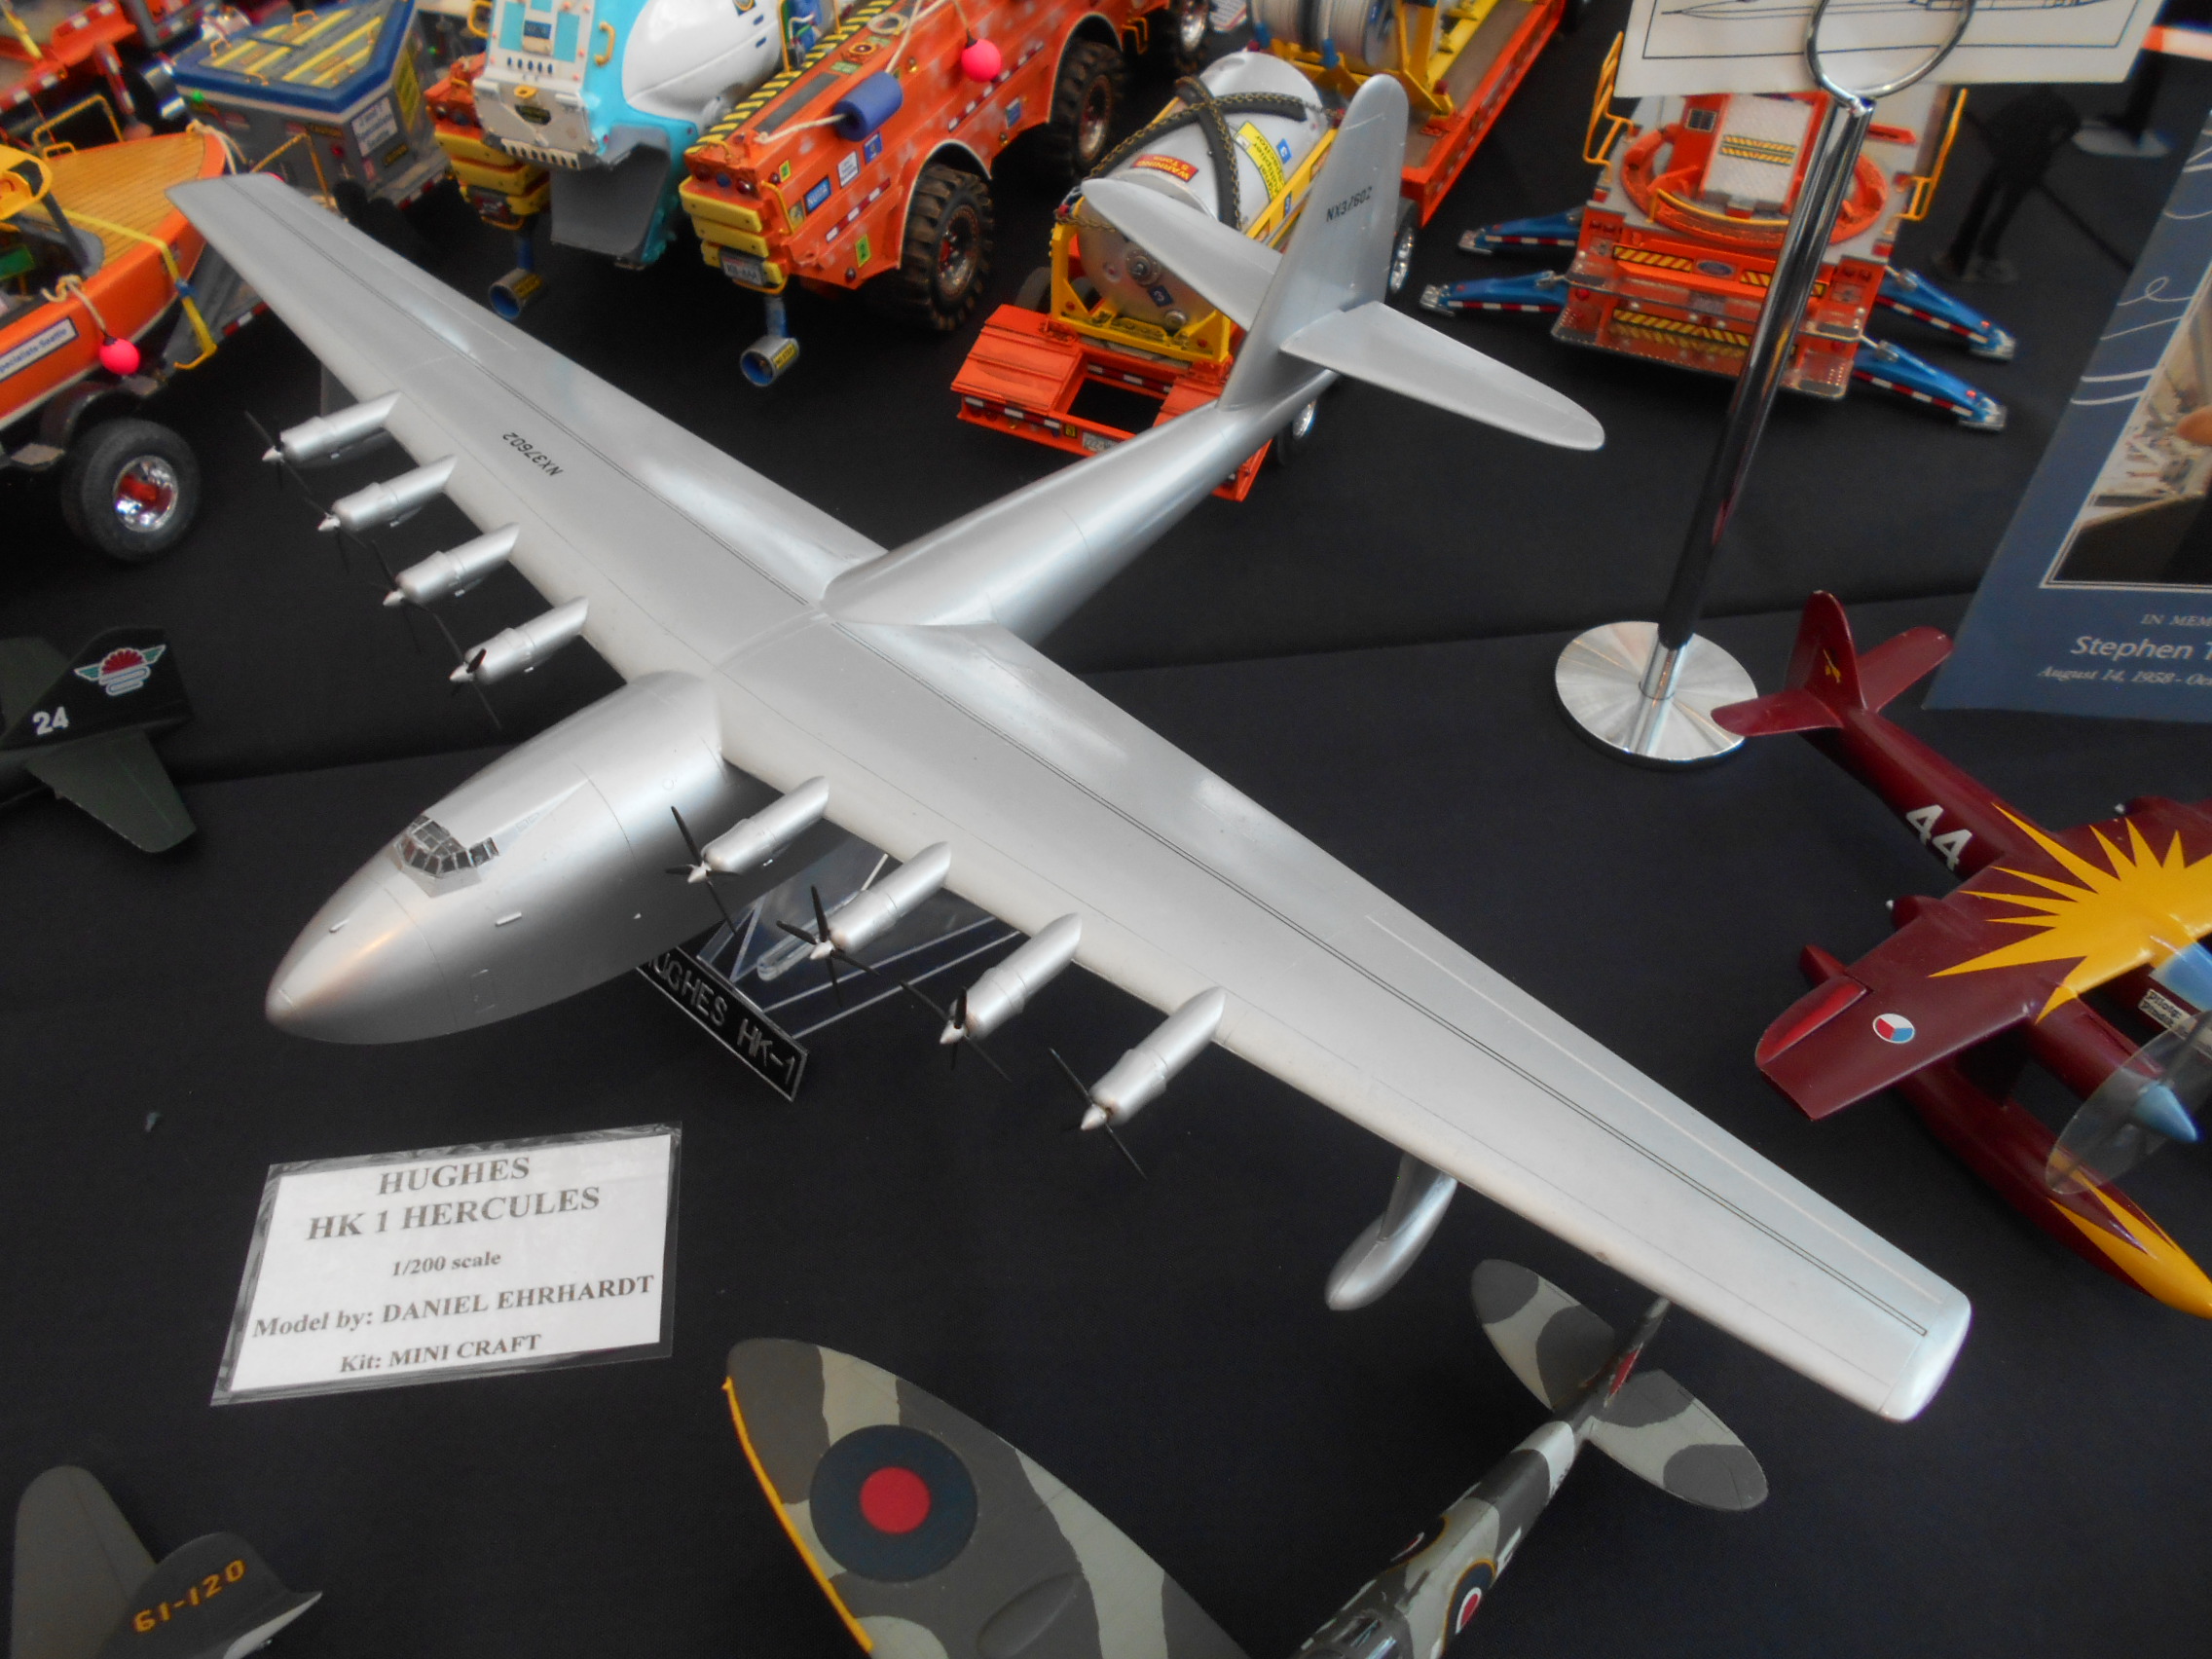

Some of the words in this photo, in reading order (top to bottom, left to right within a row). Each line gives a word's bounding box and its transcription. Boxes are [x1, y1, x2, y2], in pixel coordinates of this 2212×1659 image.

[502, 431, 565, 476] NX37602
[2141, 613, 2165, 625] IN
[2070, 636, 2194, 662] Stephen
[2037, 666, 2099, 682] August
[32, 706, 69, 736] 24
[1905, 804, 1972, 872] 44
[647, 952, 728, 1027] UGHES
[737, 1017, 796, 1086] HK-1
[378, 1157, 530, 1196] HUGHES
[307, 1212, 365, 1240] HK
[376, 1210, 388, 1233] 1
[401, 1186, 600, 1230] HERCULES
[392, 1256, 446, 1276] 1/200
[452, 1251, 501, 1270] scale
[252, 1311, 329, 1337] Model
[336, 1310, 373, 1331] by:
[381, 1293, 489, 1323] DANIEL
[497, 1274, 654, 1310] EHRHARDT
[340, 1354, 382, 1373] Kit:
[389, 1345, 450, 1367] MINI
[457, 1334, 541, 1359] CRAFT
[133, 1559, 245, 1632] 61-120
